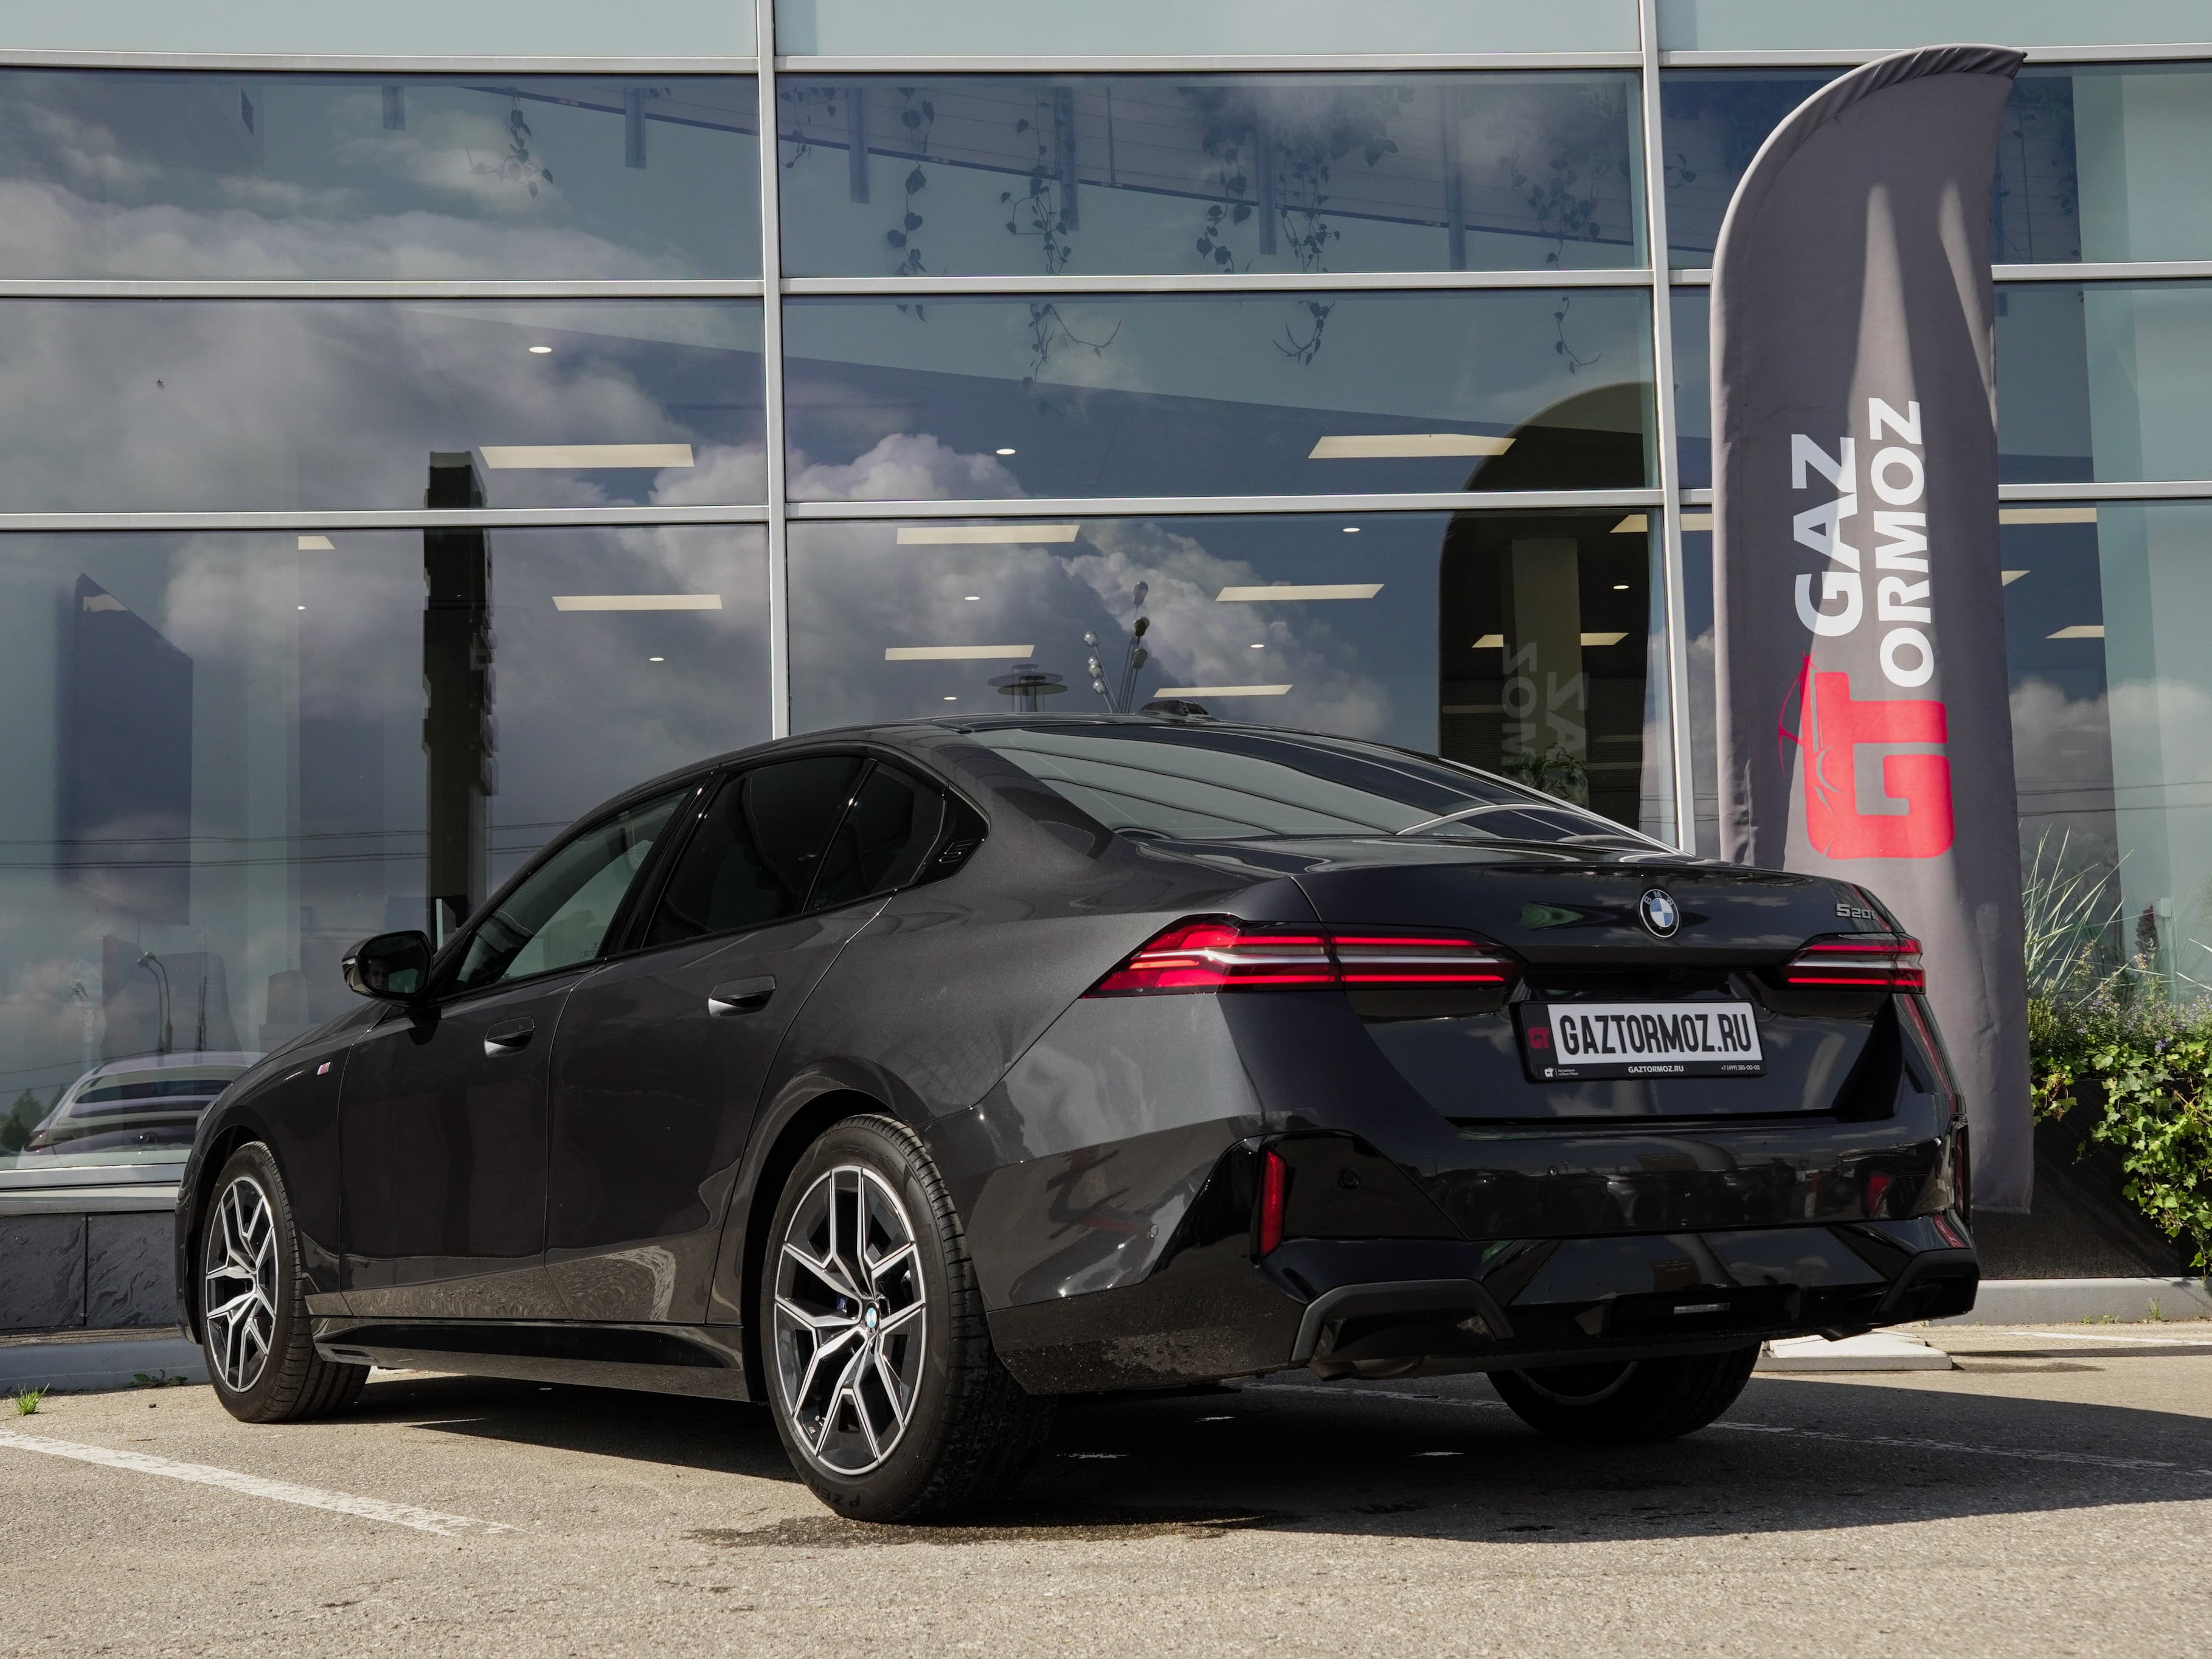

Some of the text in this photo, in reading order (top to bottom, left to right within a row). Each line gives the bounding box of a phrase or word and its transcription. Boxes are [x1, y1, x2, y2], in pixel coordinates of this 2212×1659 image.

[1791, 434, 1863, 637] GAZ
[1868, 397, 1935, 688] ORMOZ
[1559, 1014, 1752, 1055] GAZTORMOZ.RU
[1628, 1065, 1684, 1073] GAZTORMOZ.RU
